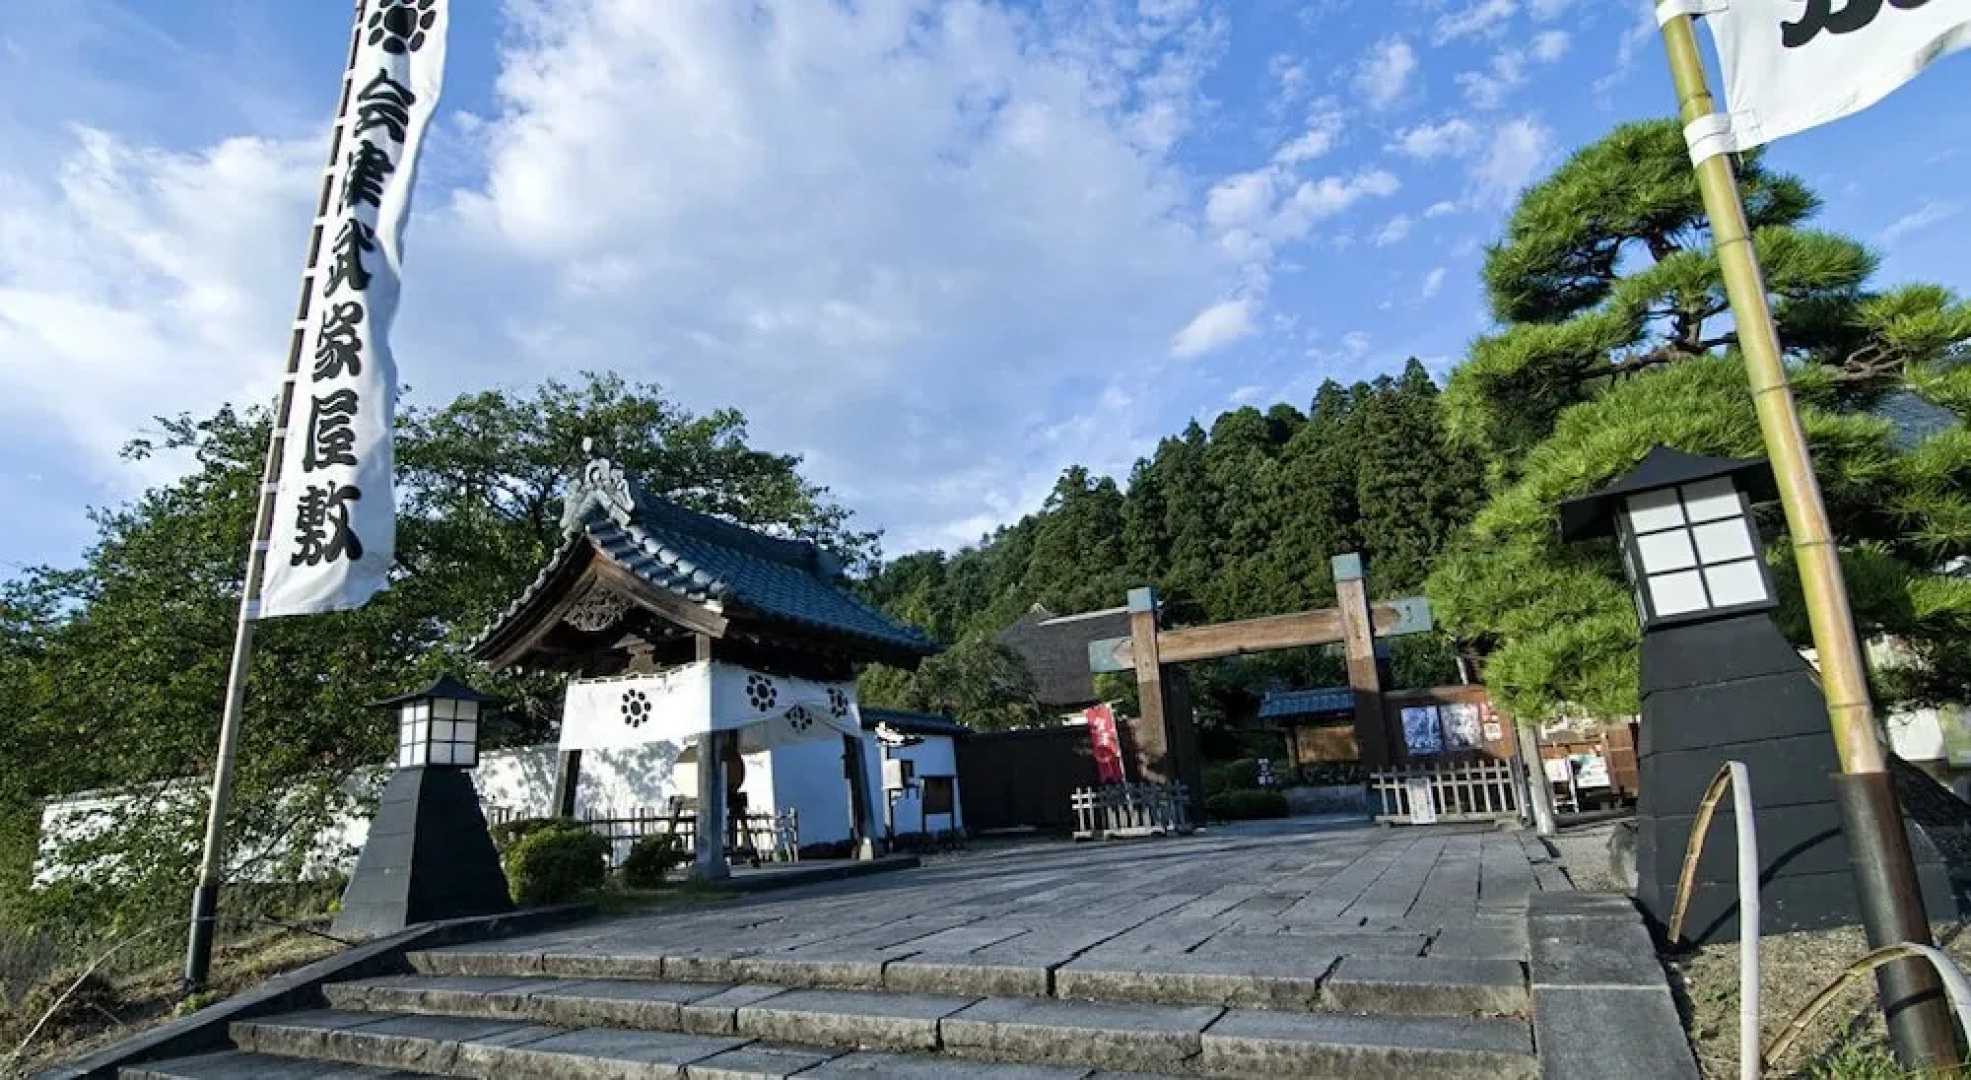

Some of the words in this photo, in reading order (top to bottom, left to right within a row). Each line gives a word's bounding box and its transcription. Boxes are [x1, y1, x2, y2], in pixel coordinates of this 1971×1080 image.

[290, 68, 416, 567] 会津武家屋敷
